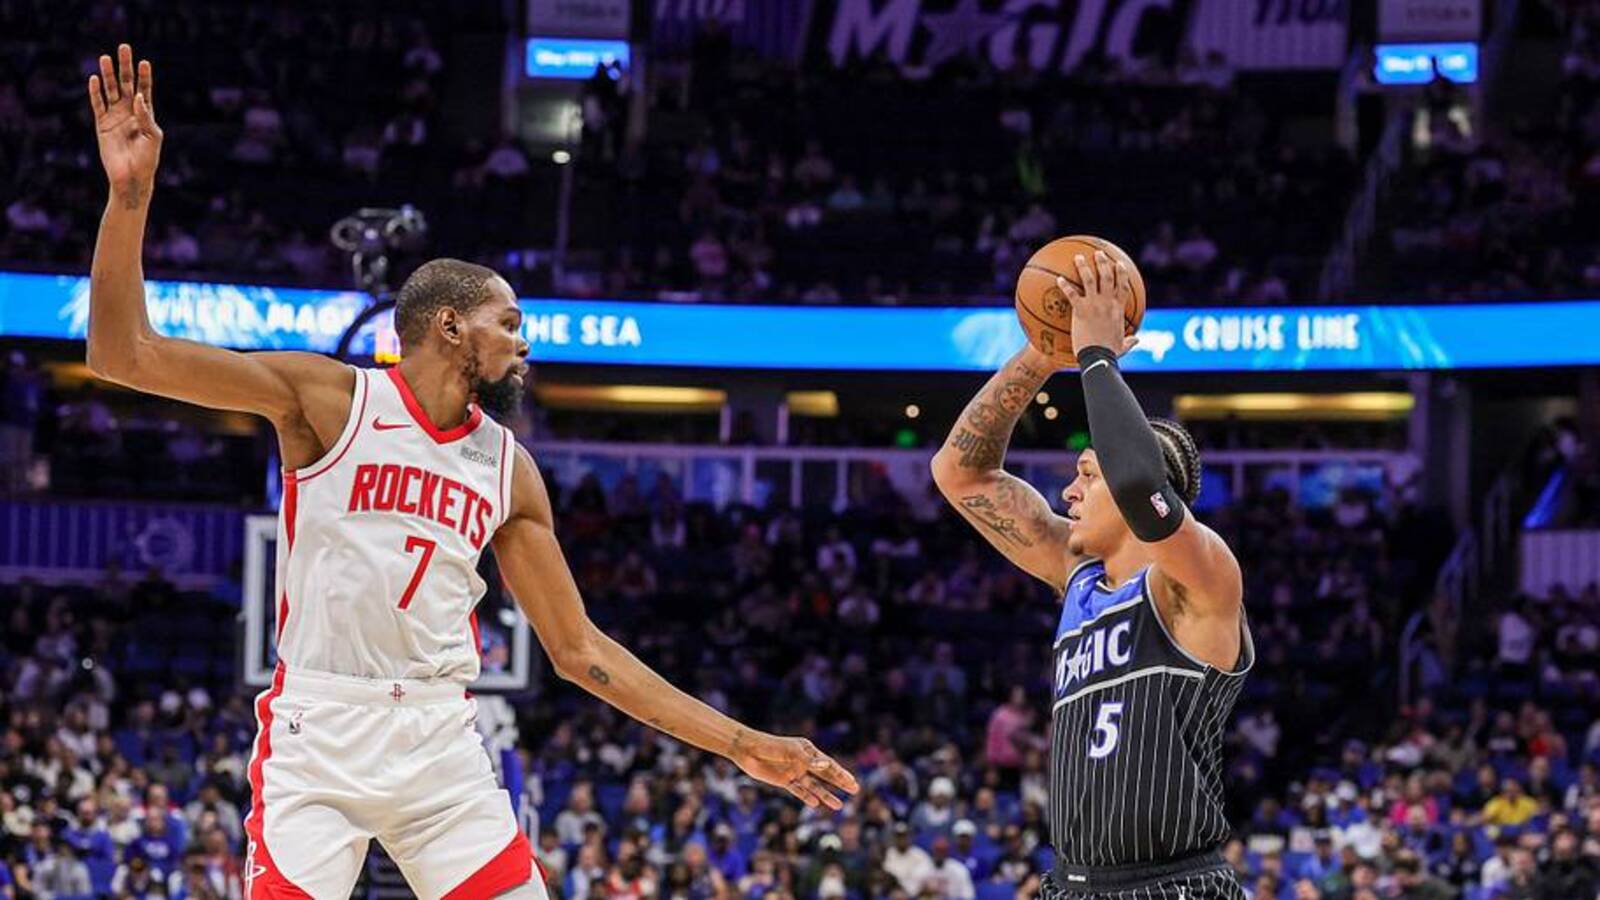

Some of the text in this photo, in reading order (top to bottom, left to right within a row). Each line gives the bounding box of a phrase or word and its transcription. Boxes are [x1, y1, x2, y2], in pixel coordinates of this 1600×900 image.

[524, 313, 571, 345] HE
[580, 314, 642, 347] SEA
[1183, 315, 1286, 350] CRUISE
[1297, 313, 1360, 350] LINE
[348, 463, 494, 551] ROCKETS
[397, 536, 437, 610] 7
[1088, 702, 1124, 760] 5
